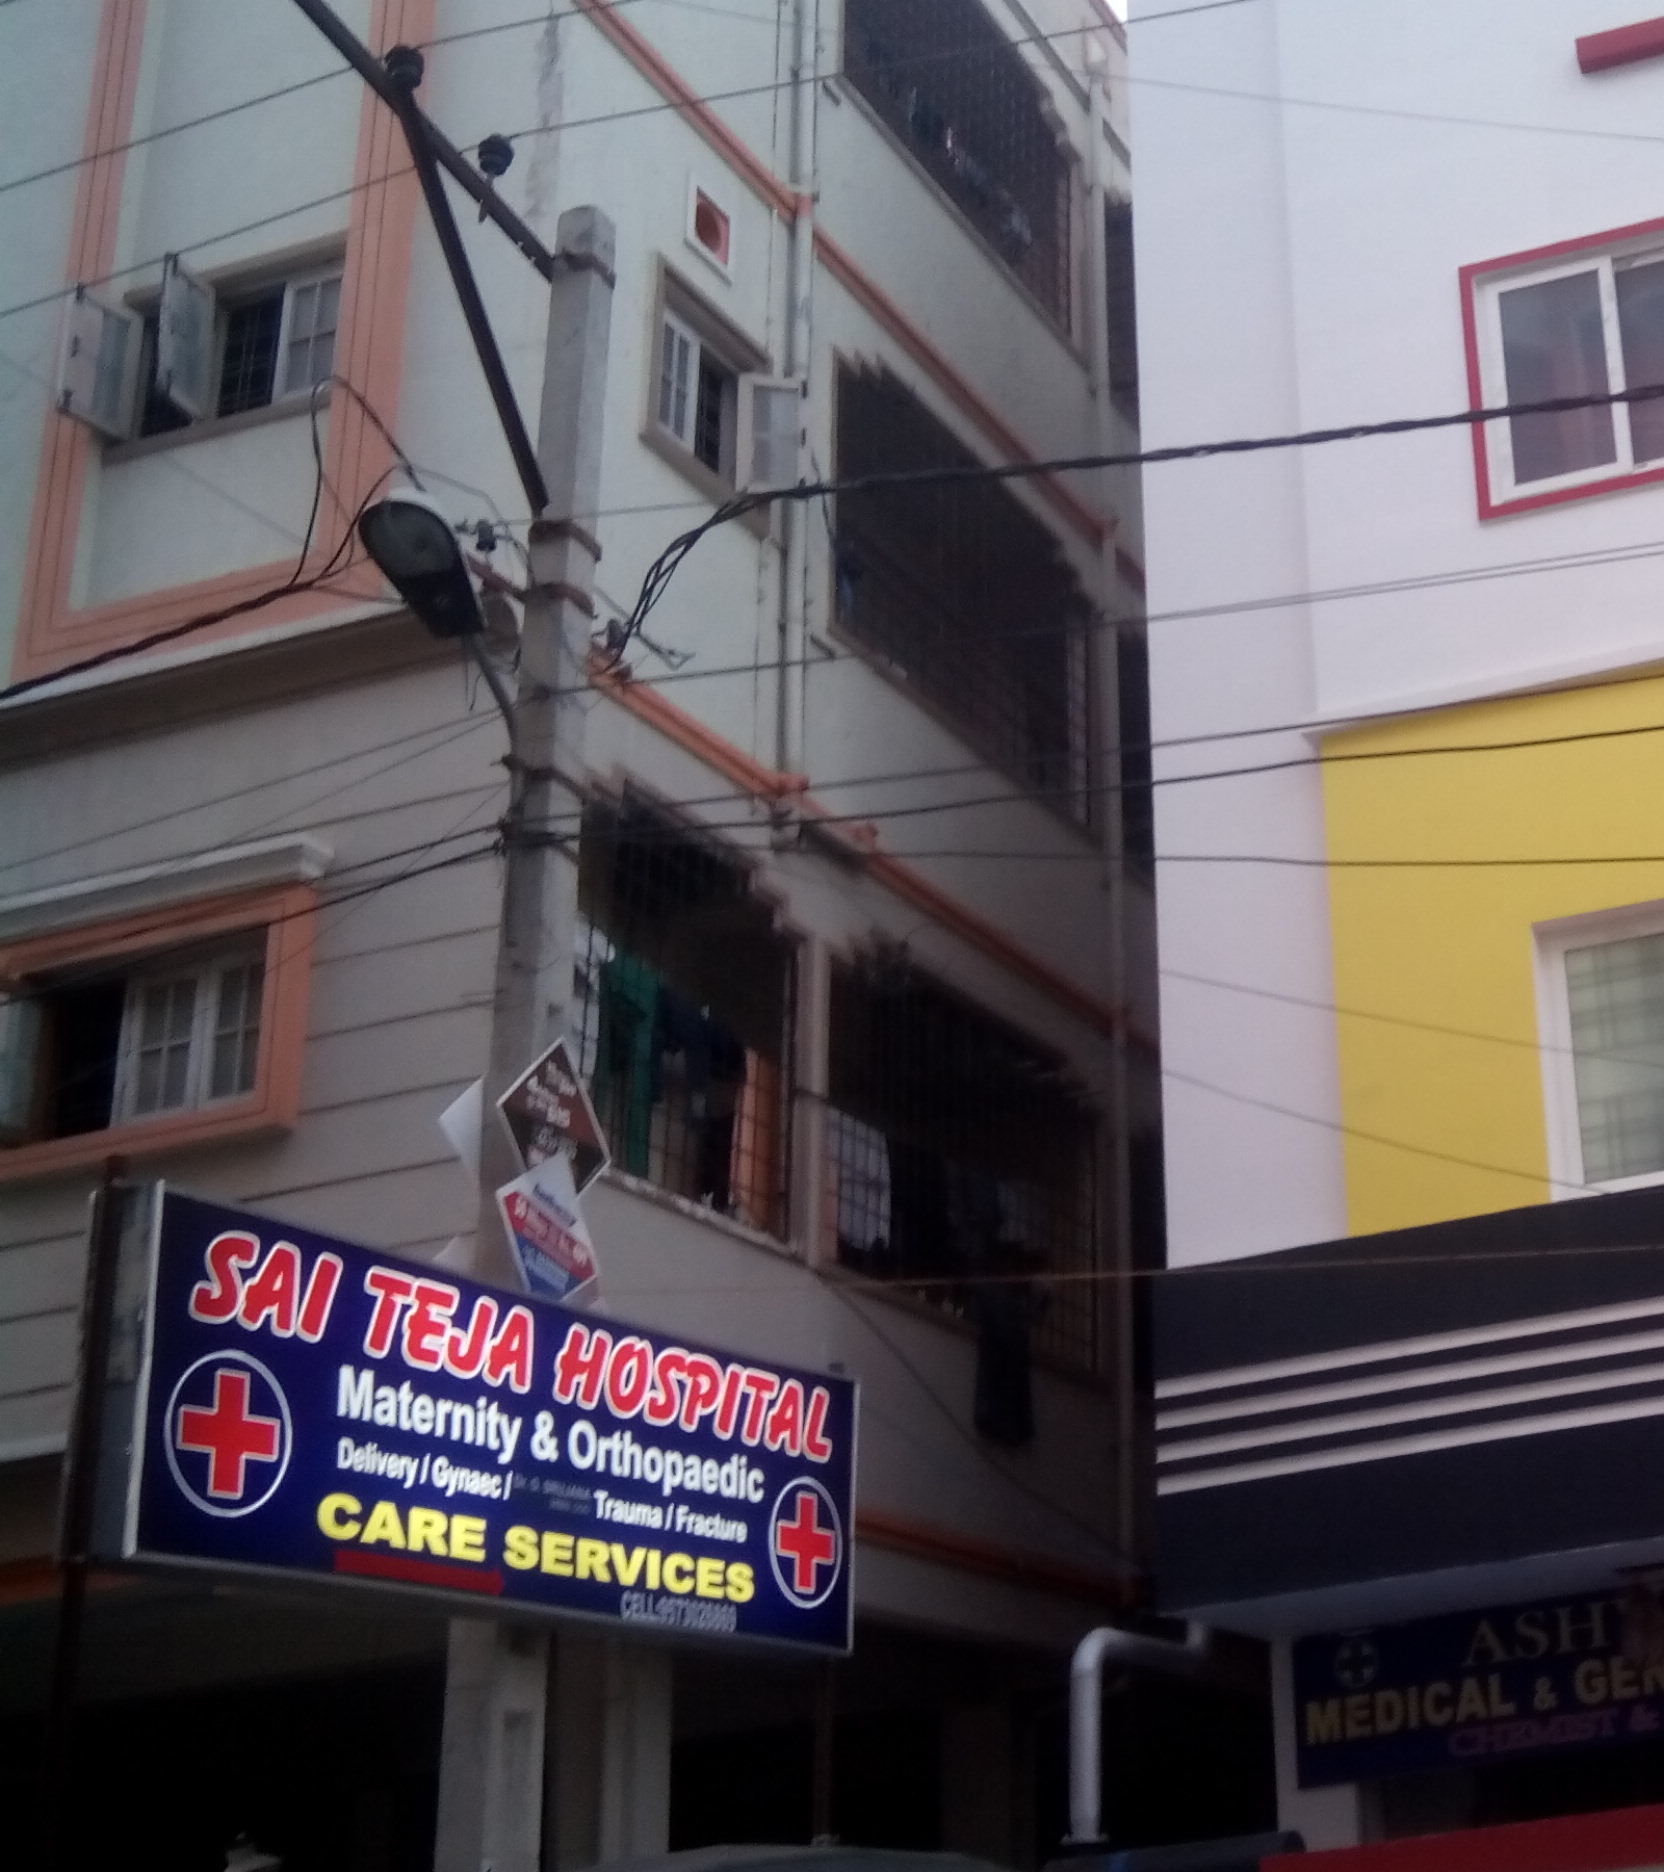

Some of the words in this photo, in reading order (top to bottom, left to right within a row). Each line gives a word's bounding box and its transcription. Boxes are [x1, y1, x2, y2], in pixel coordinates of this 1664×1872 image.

[188, 1230, 343, 1343] SAI
[363, 1266, 533, 1394] TEJA
[553, 1322, 832, 1463] HOSPITAL
[337, 1364, 522, 1464] Maternity
[530, 1410, 559, 1462] &
[568, 1419, 765, 1503] Orthopaedic
[337, 1437, 419, 1488] Delivery
[432, 1456, 501, 1497] Gynaec
[594, 1490, 663, 1529] Trauma
[676, 1505, 747, 1544] Fracture
[316, 1493, 486, 1562] CARE
[503, 1525, 755, 1603] SERVICES
[1306, 1672, 1518, 1746] MEDICAL
[1533, 1676, 1559, 1712] &
[1447, 1707, 1620, 1758] CHEMIST
[1629, 1704, 1660, 1731] &
